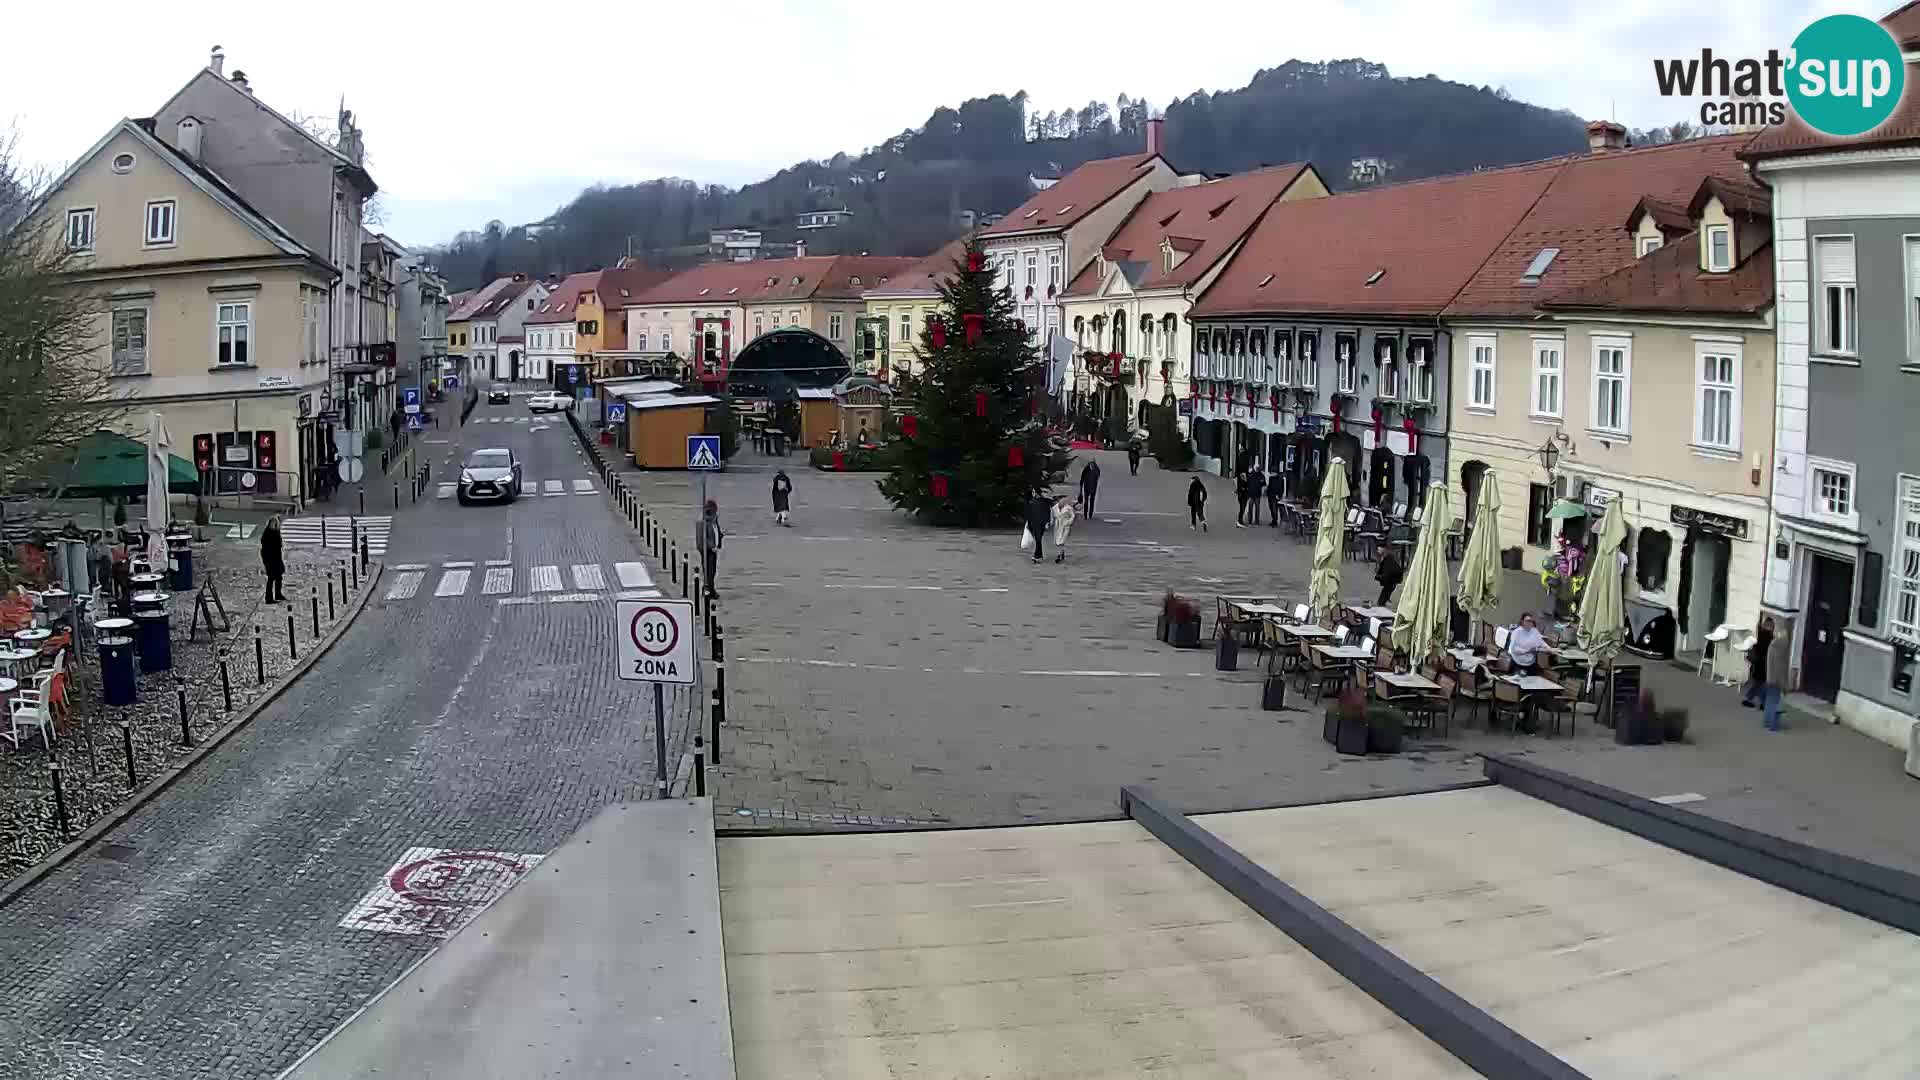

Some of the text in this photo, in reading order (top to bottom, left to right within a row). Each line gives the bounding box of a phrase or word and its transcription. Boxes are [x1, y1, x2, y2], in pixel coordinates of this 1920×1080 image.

[407, 391, 416, 403] P
[643, 622, 668, 643] 30
[633, 659, 678, 676] ZONA
